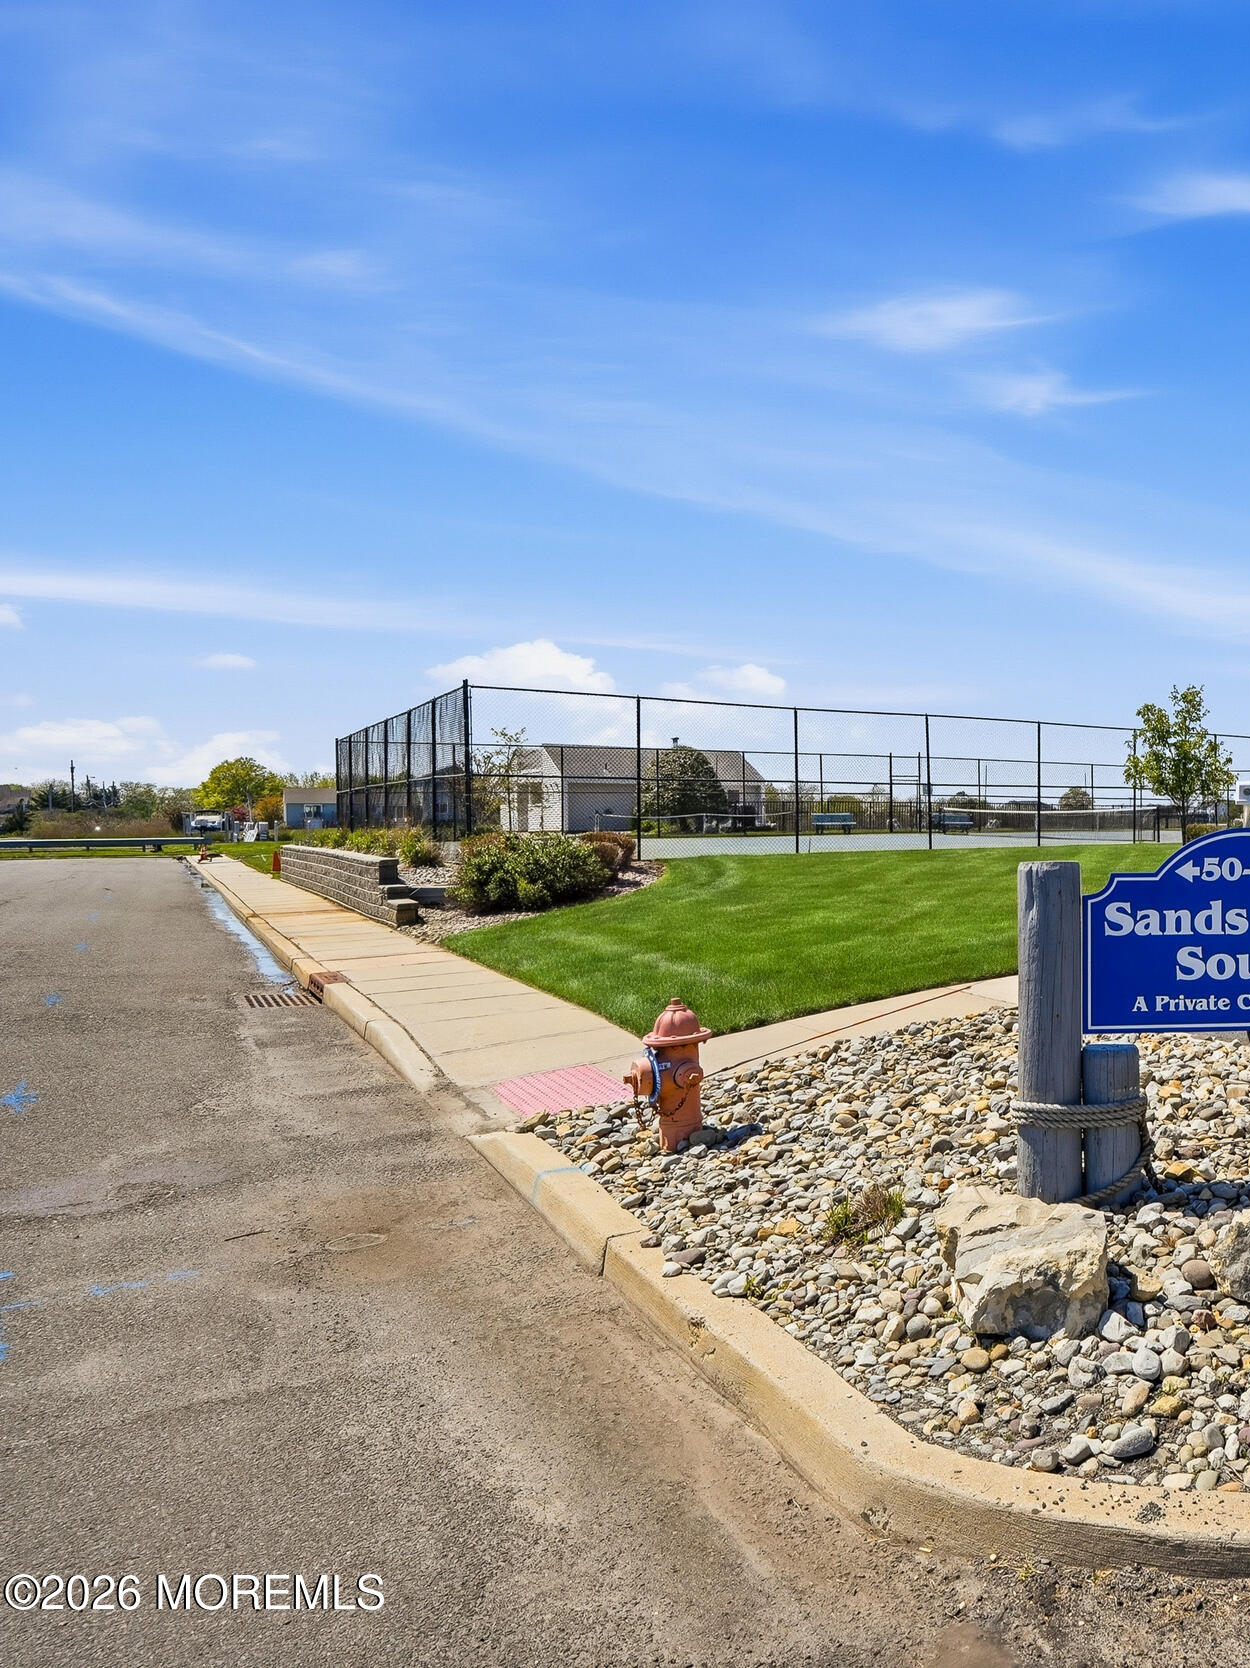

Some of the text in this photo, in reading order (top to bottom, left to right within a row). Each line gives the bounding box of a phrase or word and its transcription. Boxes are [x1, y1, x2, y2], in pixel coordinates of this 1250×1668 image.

[1104, 900, 1249, 937] Sands
[1132, 996, 1148, 1012] A
[1155, 995, 1230, 1011] Private
